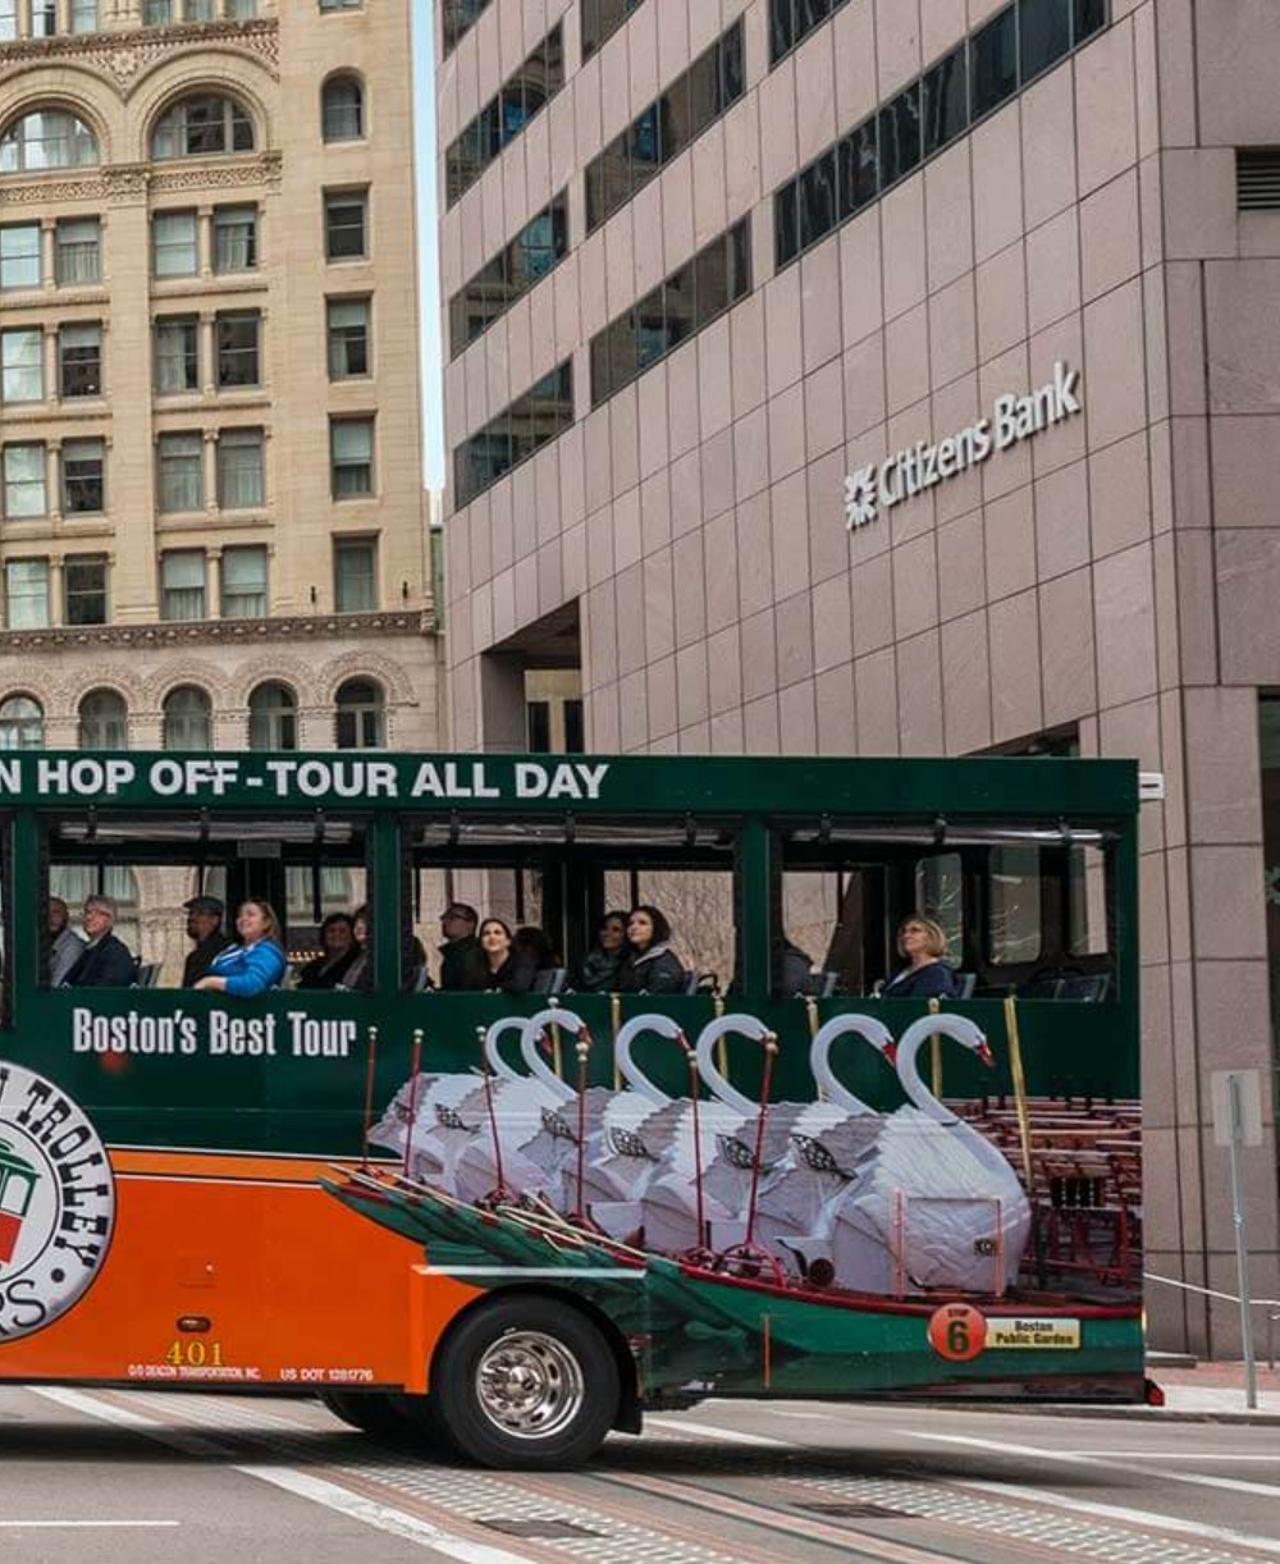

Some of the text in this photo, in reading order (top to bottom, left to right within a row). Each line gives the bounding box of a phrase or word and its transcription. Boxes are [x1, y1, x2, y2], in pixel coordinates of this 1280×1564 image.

[878, 360, 1081, 508] Citizens Bank
[38, 759, 134, 794] HOP
[411, 762, 499, 798] ALL
[516, 763, 607, 799] DAY
[73, 1008, 356, 1056] Boston's Best Tour
[16, 1079, 109, 1268] TROLLEY
[947, 1320, 970, 1352] 6
[996, 1332, 1073, 1344] Public Garden
[1015, 1320, 1053, 1332] Boston
[167, 1339, 224, 1366] 401
[280, 1367, 298, 1380] US
[301, 1367, 324, 1381] DOT
